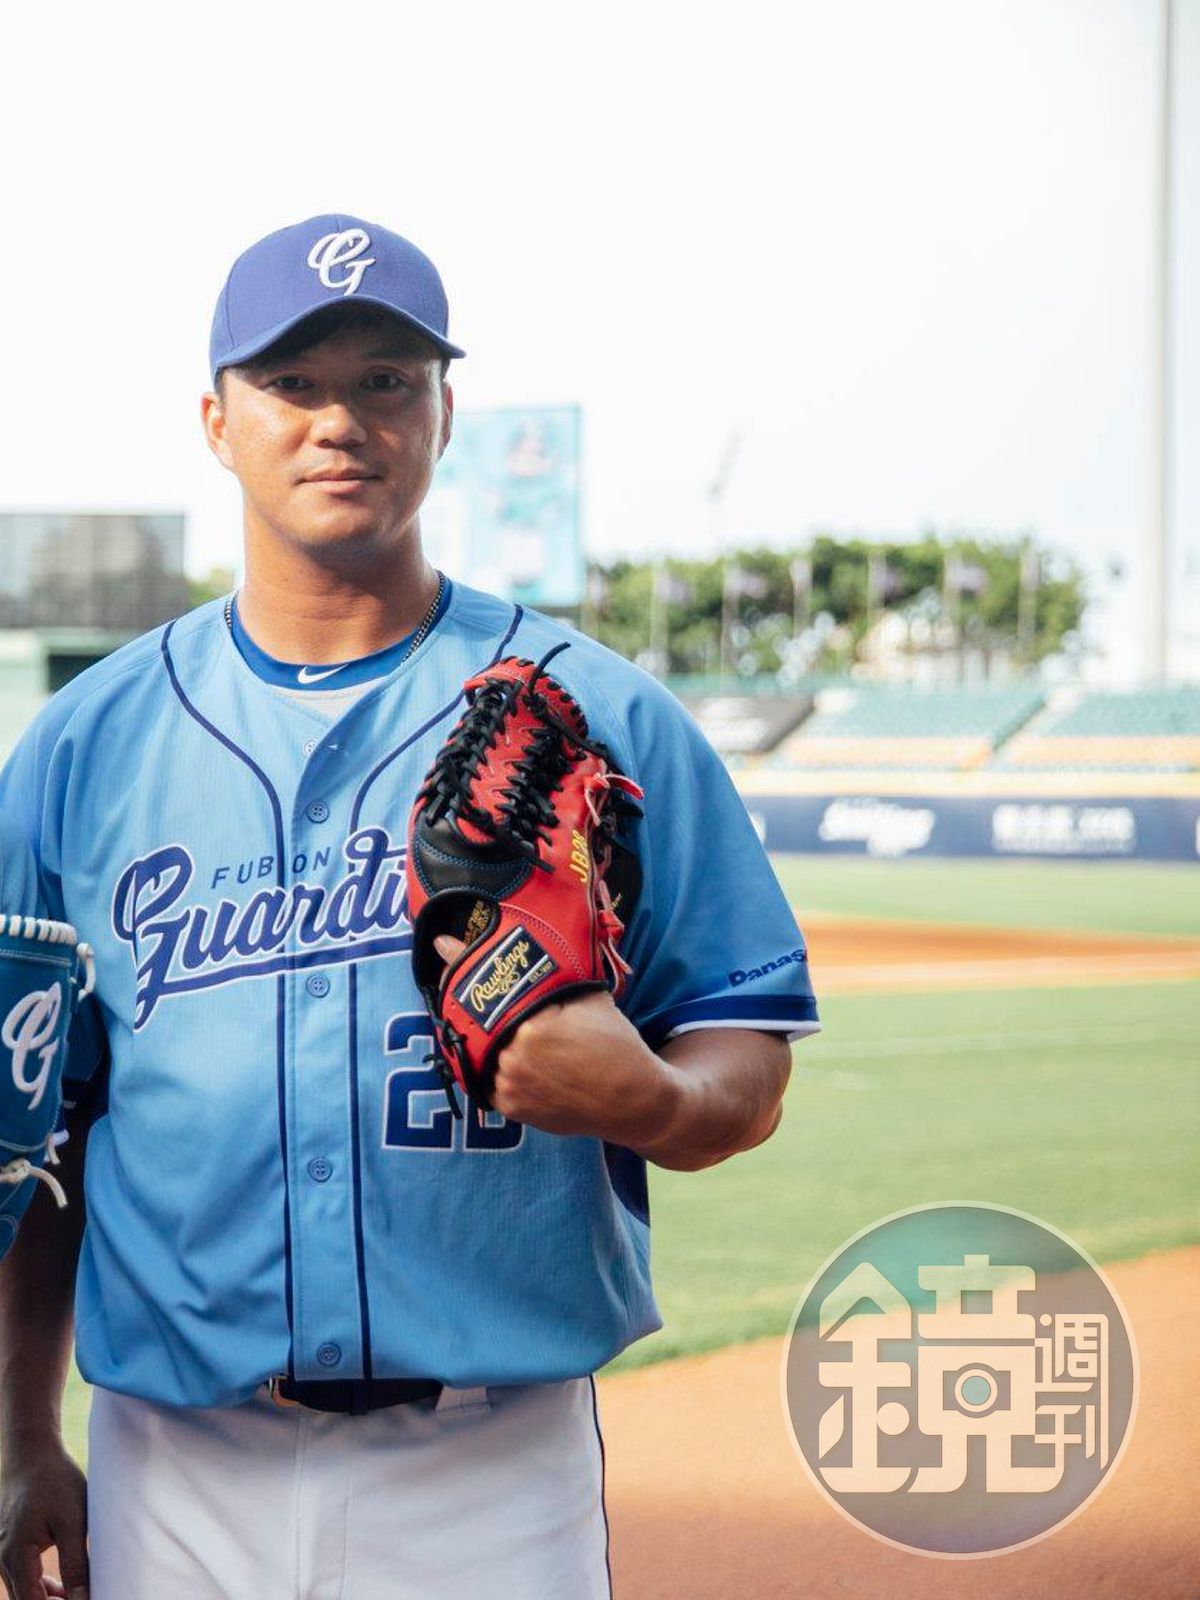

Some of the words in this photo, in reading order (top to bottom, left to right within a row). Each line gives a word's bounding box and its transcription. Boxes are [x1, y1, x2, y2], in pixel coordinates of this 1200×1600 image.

[307, 228, 376, 296] G
[470, 940, 530, 1012] Rawlings
[1, 981, 62, 1110] G
